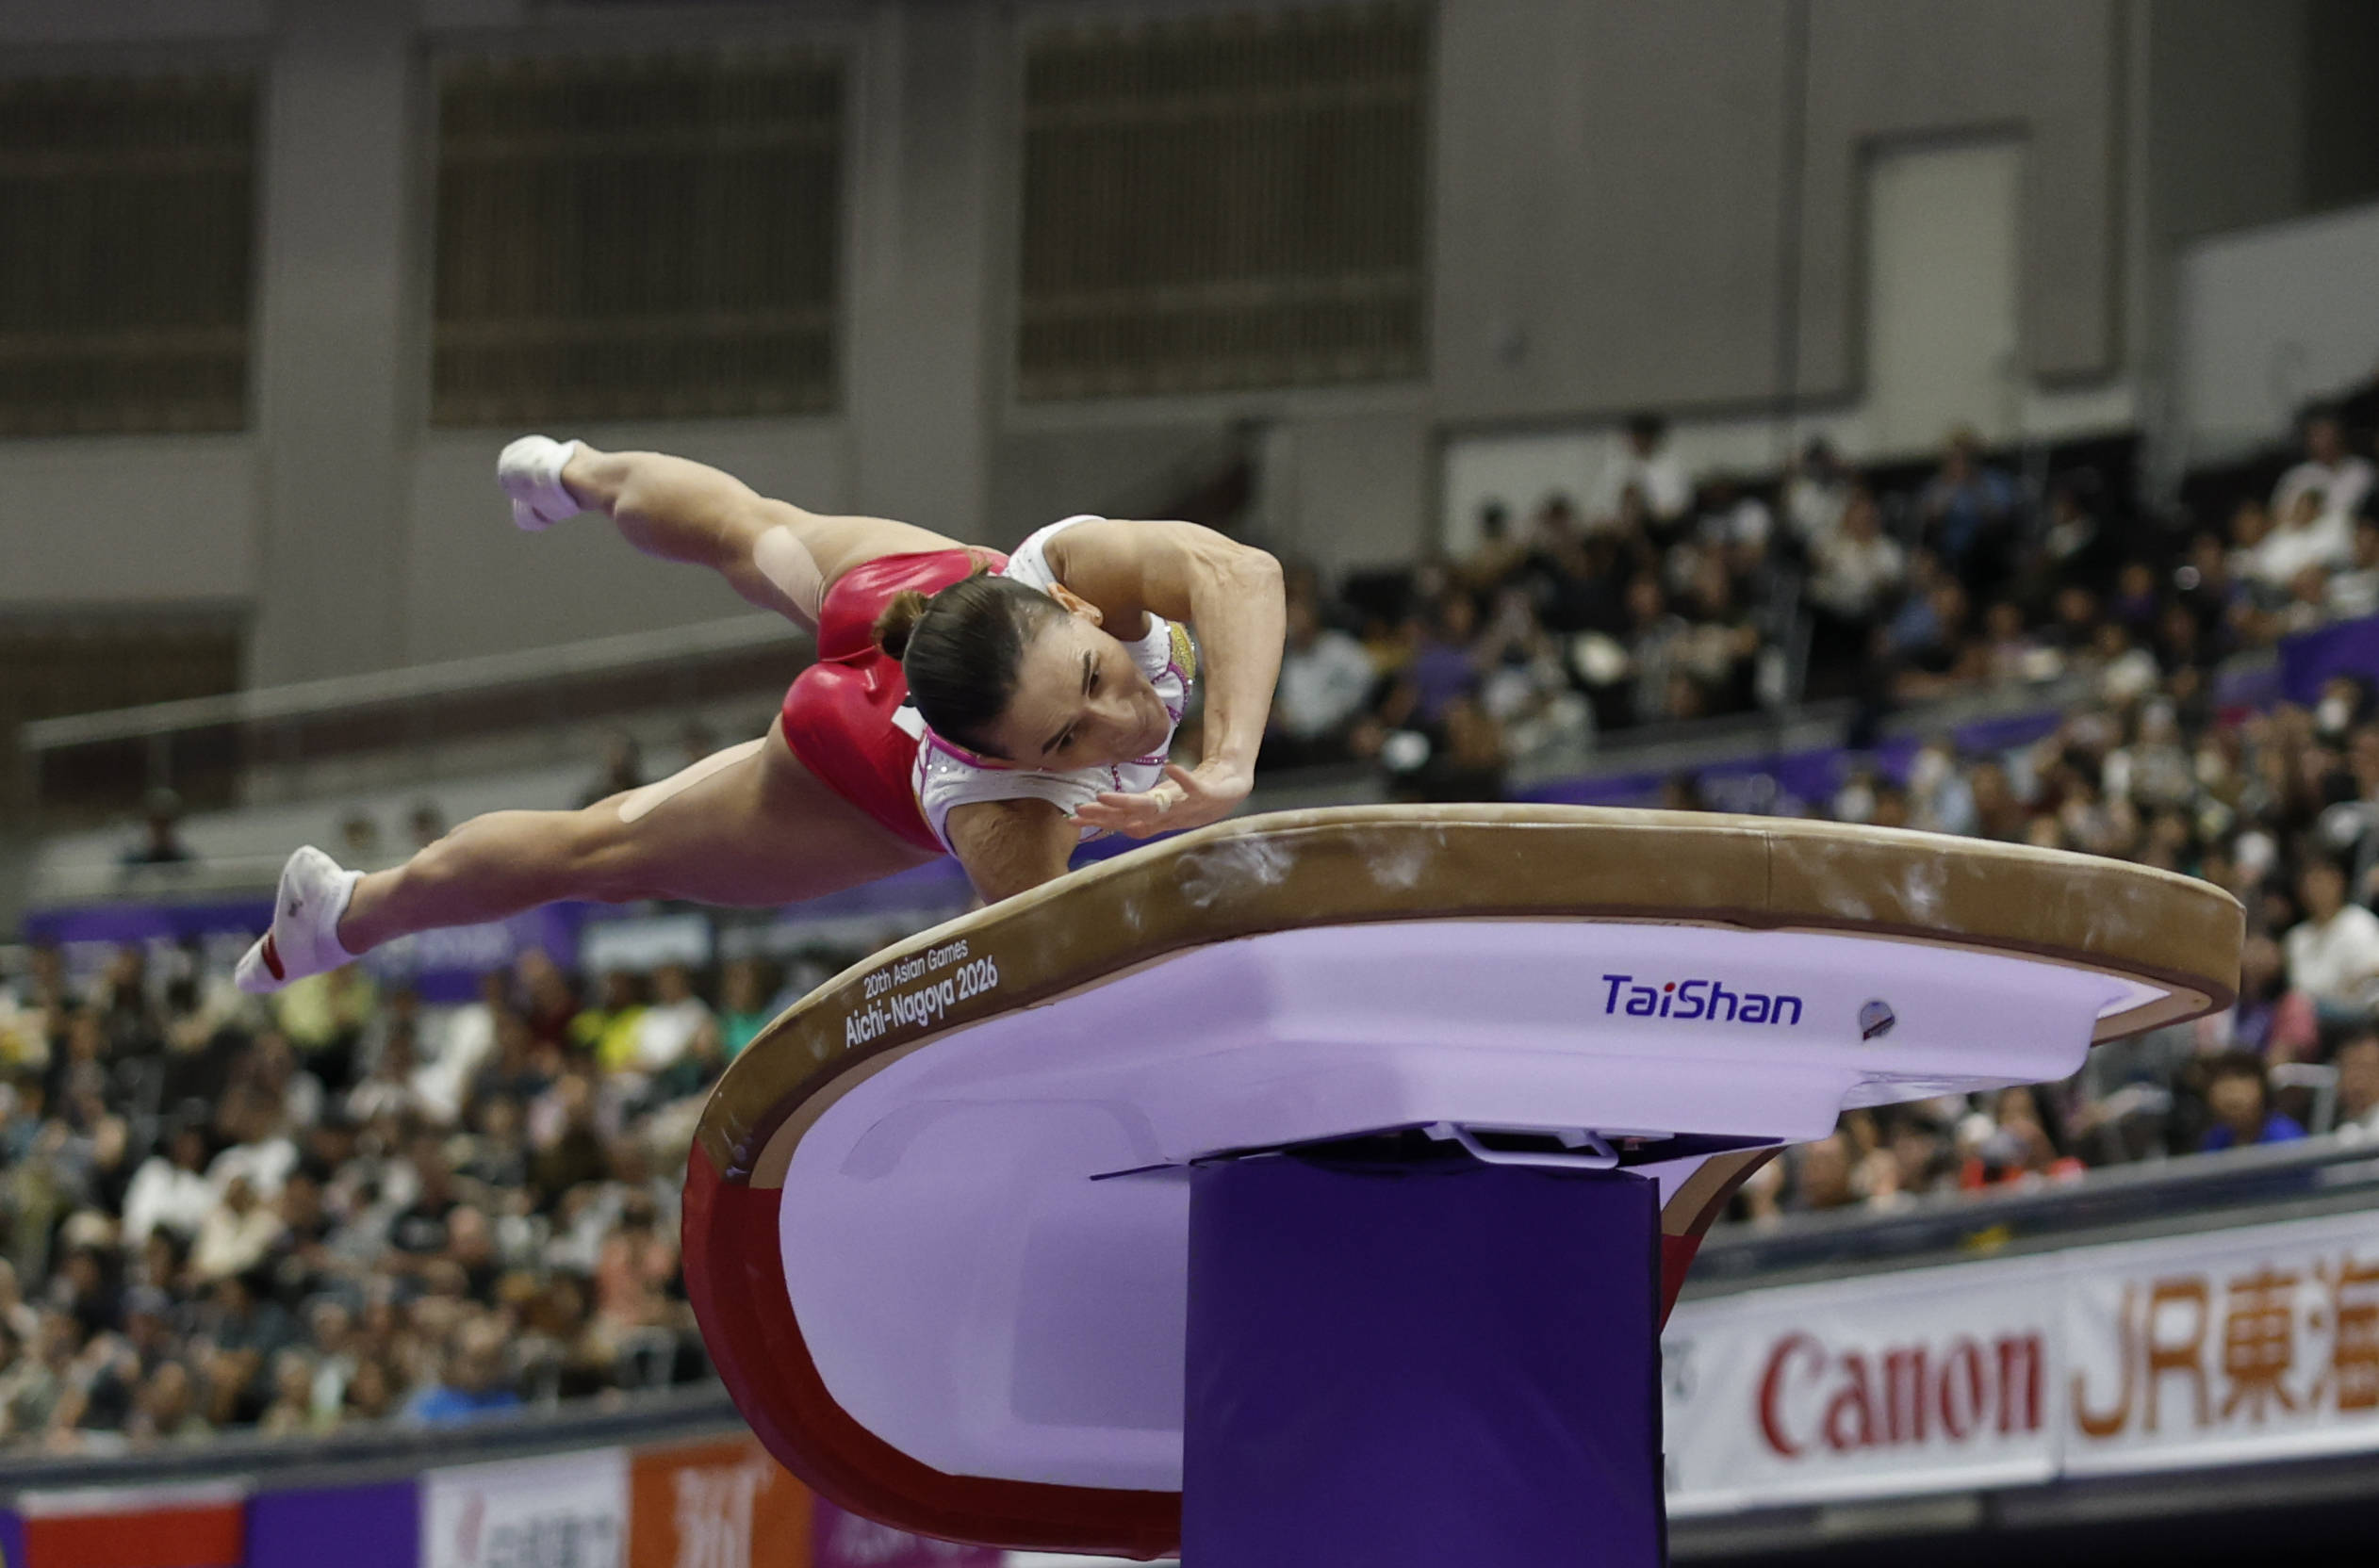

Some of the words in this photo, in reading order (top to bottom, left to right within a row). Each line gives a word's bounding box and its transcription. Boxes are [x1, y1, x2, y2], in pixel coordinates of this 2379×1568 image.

[845, 977, 956, 1048] Aichi-Nagoya
[957, 955, 998, 1000] 2026
[863, 968, 892, 999] 20th
[894, 956, 926, 986] Asian
[927, 939, 968, 971] Games
[1602, 973, 1803, 1025] TaiShan
[1757, 1328, 2045, 1462] Canon
